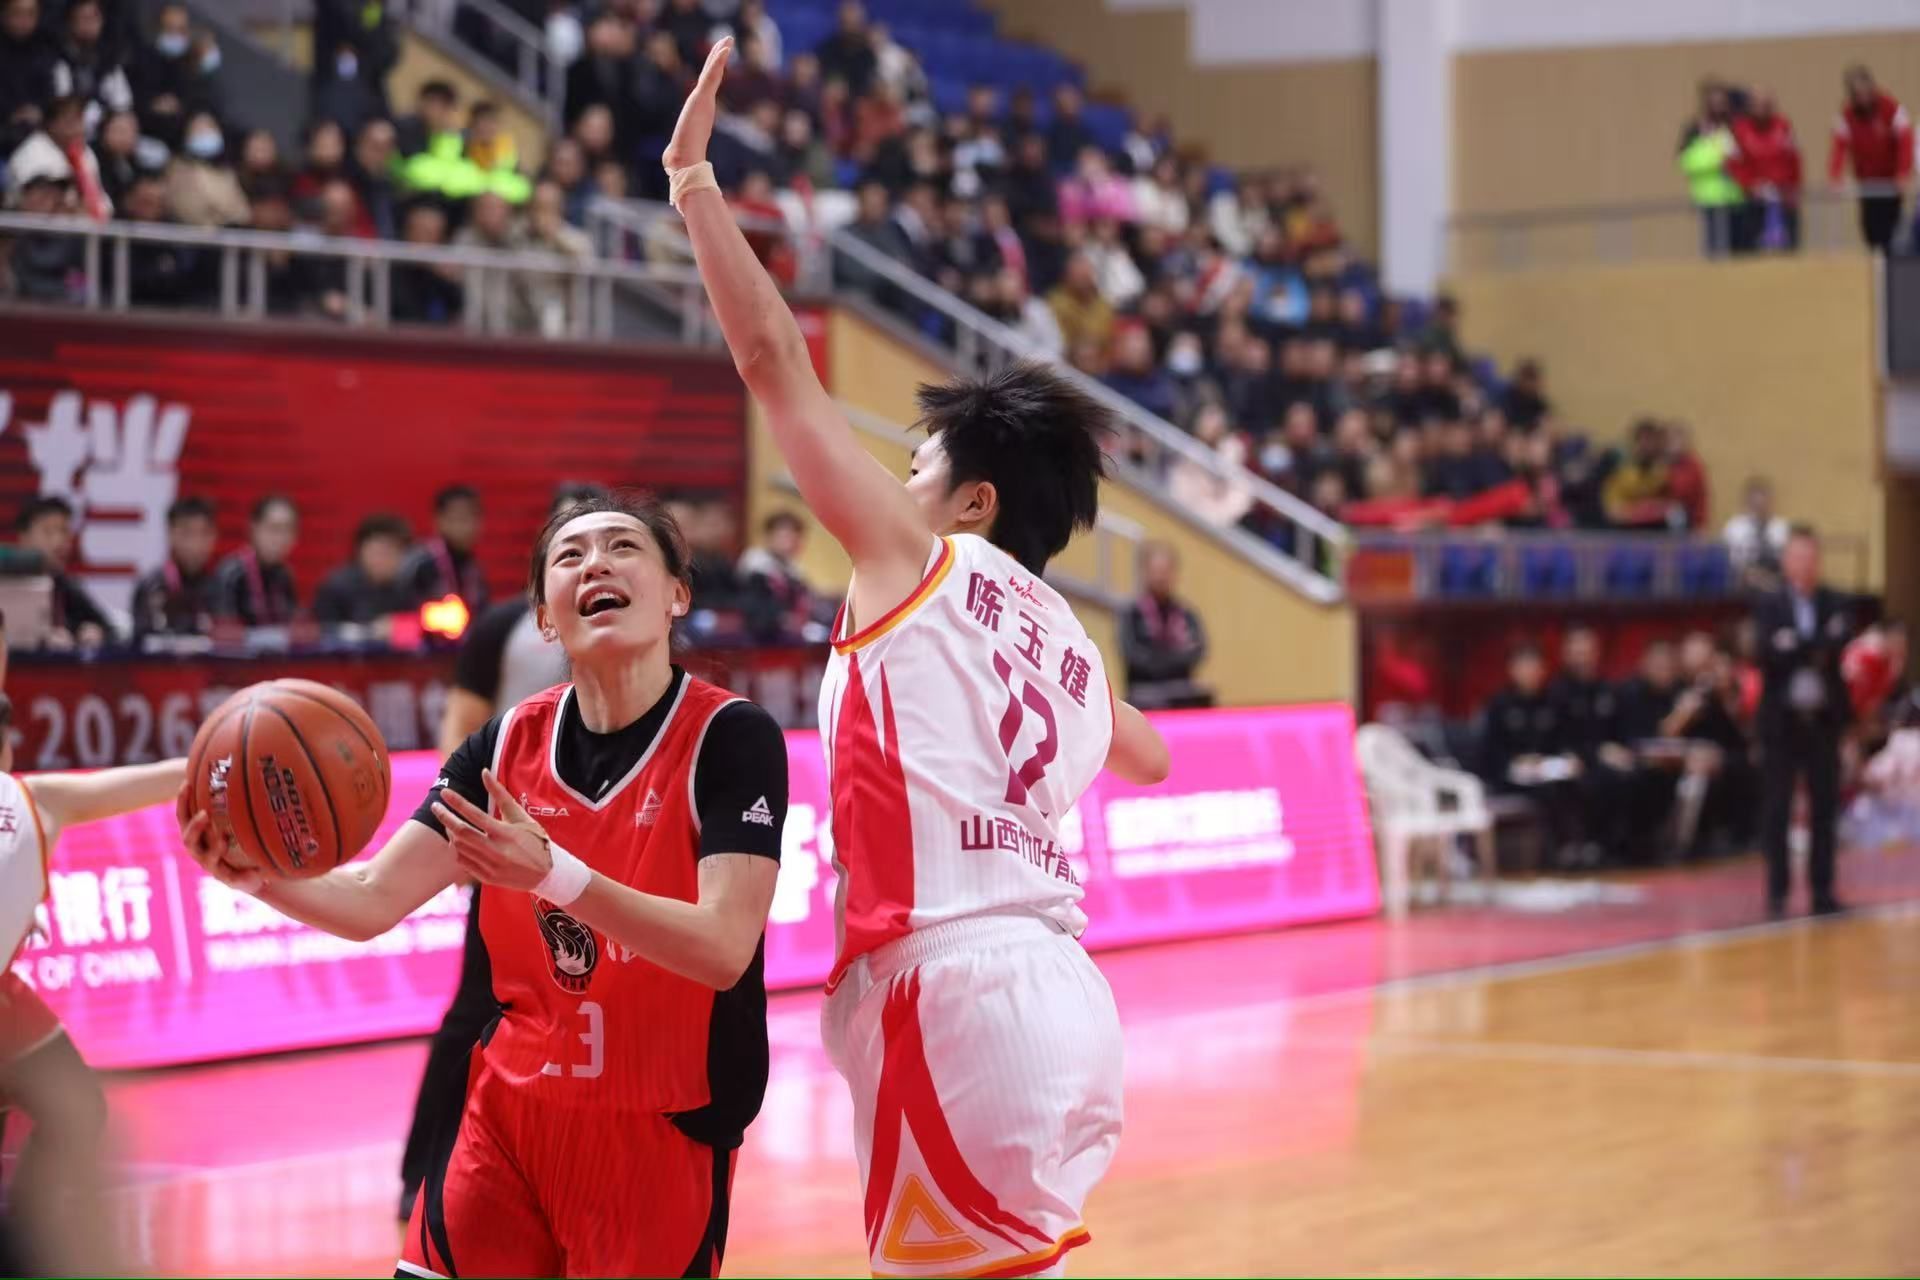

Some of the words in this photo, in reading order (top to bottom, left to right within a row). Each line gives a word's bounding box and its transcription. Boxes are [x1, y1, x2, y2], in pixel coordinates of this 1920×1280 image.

[527, 806, 570, 817] CBA
[742, 811, 773, 827] PEAK
[25, 866, 152, 951] 银行
[541, 1001, 604, 1078] 3
